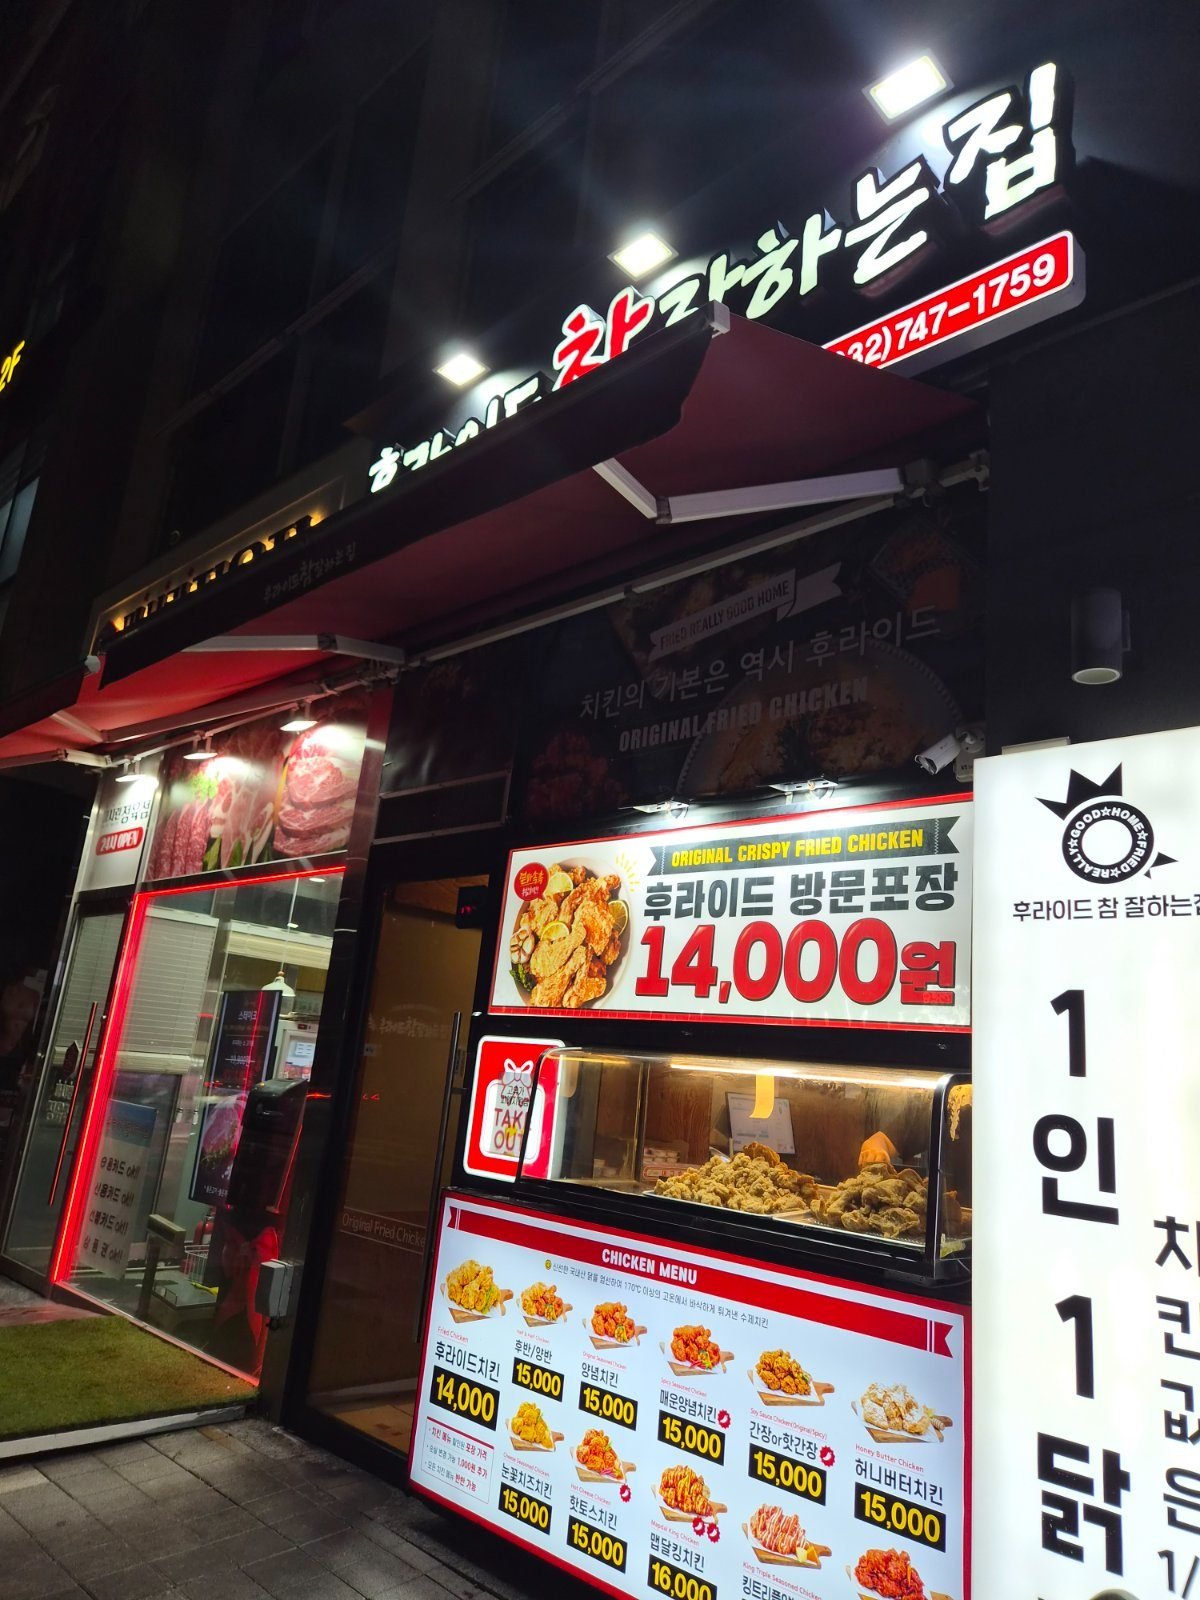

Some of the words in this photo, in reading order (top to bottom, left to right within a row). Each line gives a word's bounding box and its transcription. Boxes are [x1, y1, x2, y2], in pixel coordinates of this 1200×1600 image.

[660, 627, 687, 650] FRIED
[689, 610, 725, 637] REALLY
[727, 597, 754, 620] GOOD
[757, 580, 789, 607] HOME
[579, 679, 645, 719] 치킨의
[655, 663, 730, 703] 기본은
[737, 640, 795, 681] 역시
[805, 604, 940, 666] 후라이드
[617, 714, 705, 752] ORIGINAL
[706, 702, 761, 733] FRIED
[766, 675, 867, 717] CHICKEN
[1072, 808, 1101, 839] GOOD
[1111, 806, 1143, 831] HOME
[671, 845, 733, 868] ORIGINAL
[738, 841, 791, 863] CRISPY
[795, 836, 842, 858] FRIED
[848, 827, 925, 853] CHICKEN
[1068, 847, 1110, 878] REALLY
[1120, 840, 1147, 874] FRIED
[644, 876, 776, 922] 후라이드
[790, 862, 958, 915] 방문포장
[1012, 899, 1093, 922] 후라이드
[1096, 897, 1119, 920] 참
[495, 1108, 527, 1130] TAK
[342, 1213, 373, 1234] Original
[374, 1220, 395, 1240] Fried
[603, 1248, 657, 1276] CHICKEN
[660, 1258, 698, 1285] MENU
[553, 1263, 569, 1276] 신선한
[570, 1266, 586, 1280] 국내산
[587, 1270, 599, 1283] 닭을
[600, 1273, 622, 1289] 엄선하여
[642, 1284, 661, 1298] 이상의
[663, 1290, 688, 1307] 고온에서
[689, 1298, 715, 1314] 바삭하게
[717, 1305, 738, 1321] 튀겨낸
[740, 1312, 769, 1329] 수제치킨
[437, 1326, 448, 1336] Fried
[435, 1340, 501, 1383] 후라이드치킨
[514, 1339, 553, 1365] 후반/양반
[516, 1362, 561, 1397] 15,000
[582, 1362, 618, 1389] 양념치킨
[436, 1372, 495, 1422] 14,000
[583, 1387, 635, 1425] 15,000
[659, 1389, 717, 1425] 매운양념치킨
[662, 1416, 722, 1459] 15,000
[749, 1420, 818, 1461] 간장or핫간장
[855, 1443, 874, 1456] Honey
[876, 1450, 896, 1463] Butter
[898, 1457, 923, 1472] Chicken
[502, 1462, 553, 1501] 눈꽃치즈치킨
[753, 1450, 822, 1498] 15,000
[855, 1458, 943, 1507] 허니버터치킨
[503, 1488, 550, 1529] 15,000
[570, 1495, 617, 1531] 핫토스치킨
[860, 1491, 941, 1543] 15,000
[571, 1523, 624, 1566] 15,000
[650, 1532, 705, 1573] 맵달킹치킨
[651, 1559, 711, 1600] 16,000
